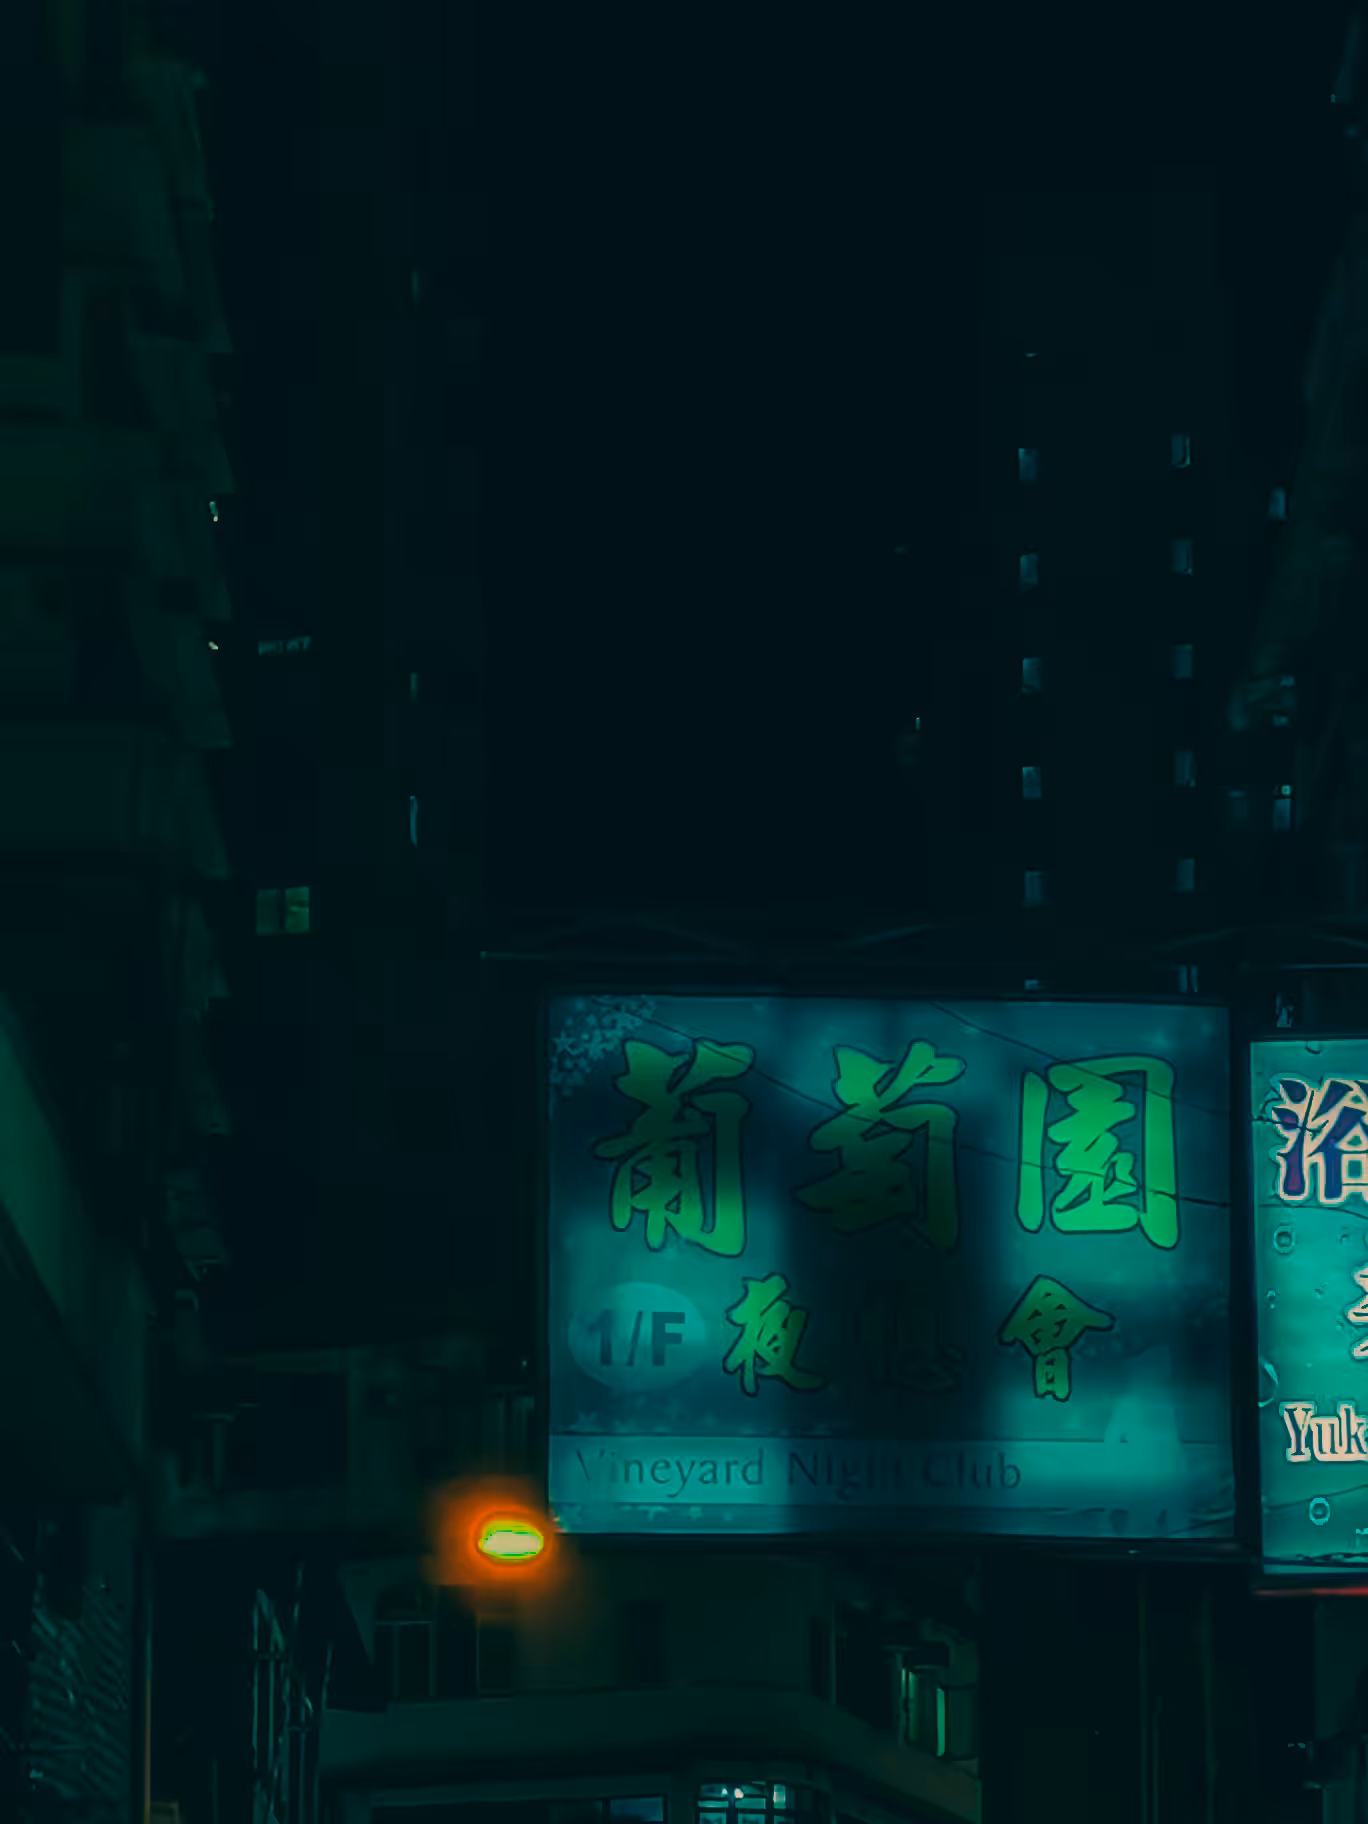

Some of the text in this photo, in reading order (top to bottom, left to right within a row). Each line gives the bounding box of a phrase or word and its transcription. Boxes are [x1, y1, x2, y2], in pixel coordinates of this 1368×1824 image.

[594, 1037, 1180, 1256] 葡萄園
[590, 1311, 688, 1368] 1/F
[1283, 1403, 1368, 1462] Yuk
[575, 1447, 766, 1500] Vineyard
[922, 1448, 1022, 1490] Club
